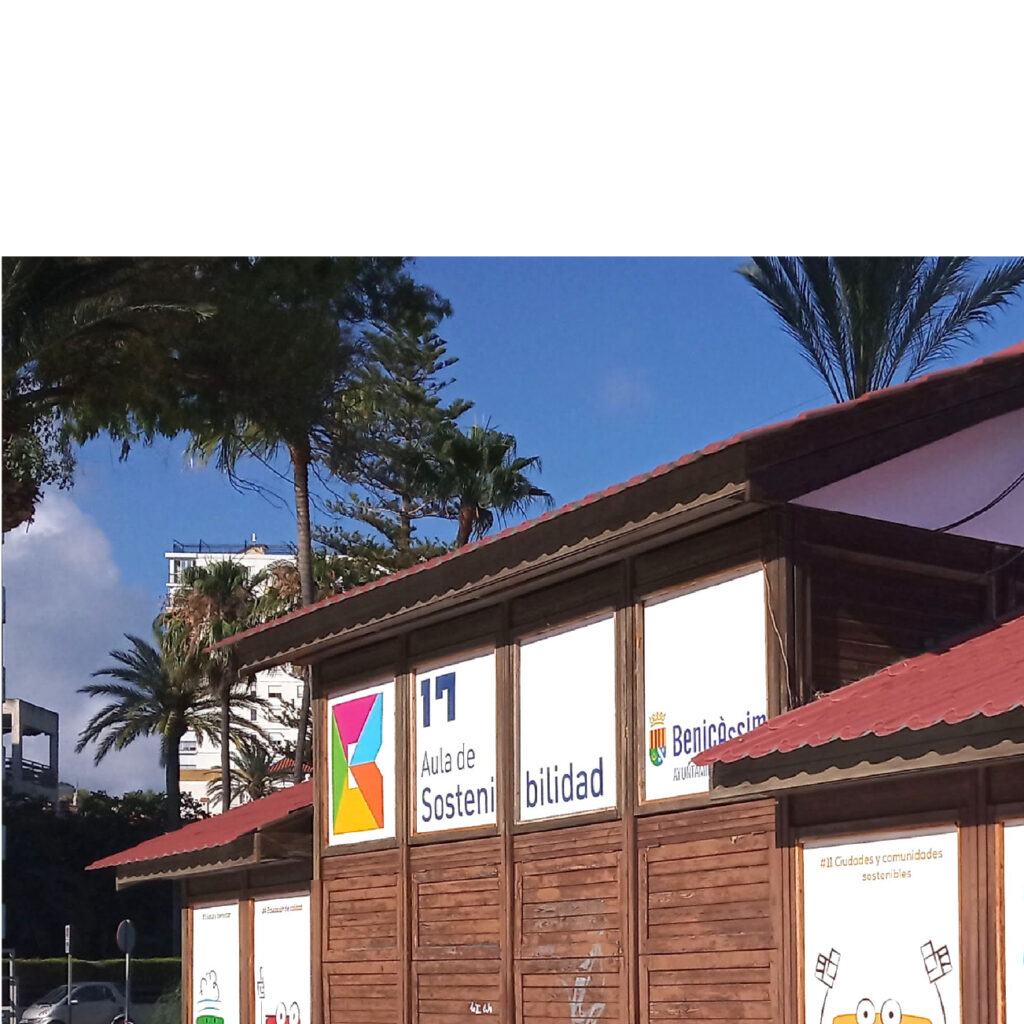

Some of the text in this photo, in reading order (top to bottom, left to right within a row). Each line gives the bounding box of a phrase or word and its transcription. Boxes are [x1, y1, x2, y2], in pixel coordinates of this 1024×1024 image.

[421, 672, 456, 728] 17
[421, 742, 476, 778] Aula de
[422, 756, 604, 823] Sosteni bilidad
[834, 854, 874, 867] Ciudades
[875, 856, 881, 866] y
[882, 848, 943, 863] comunidades
